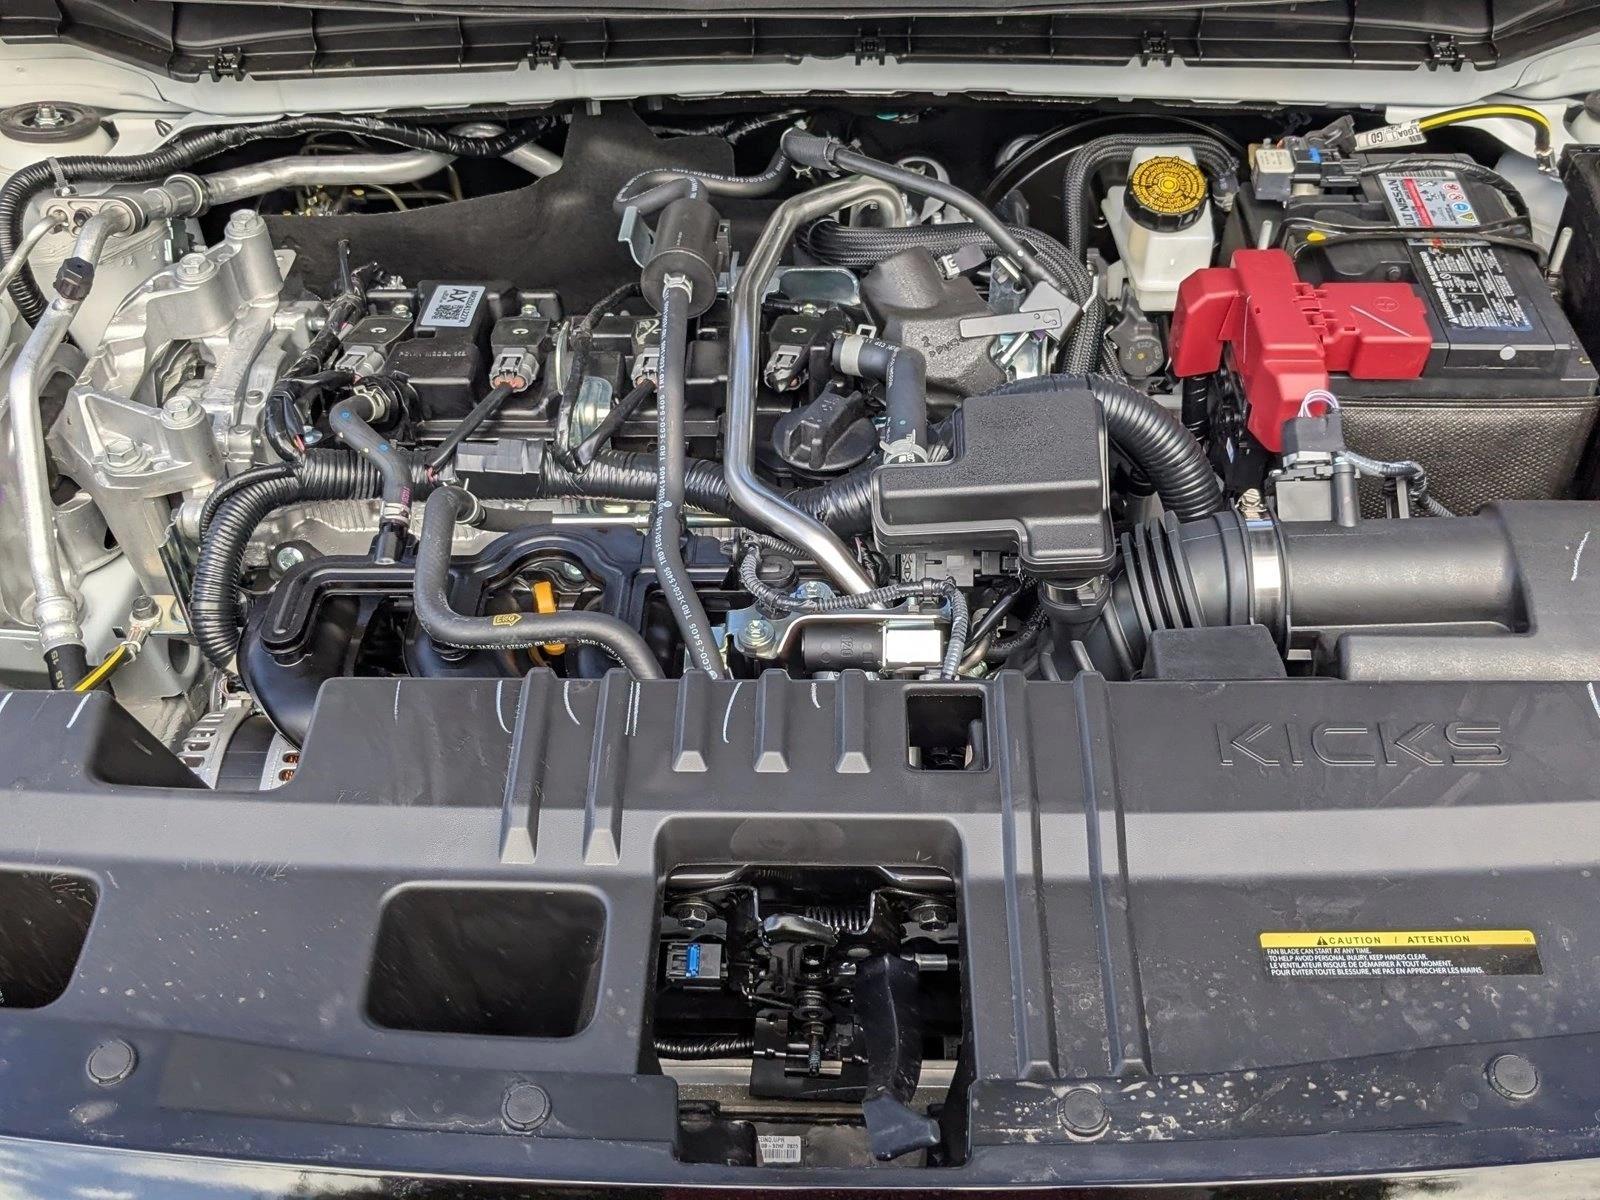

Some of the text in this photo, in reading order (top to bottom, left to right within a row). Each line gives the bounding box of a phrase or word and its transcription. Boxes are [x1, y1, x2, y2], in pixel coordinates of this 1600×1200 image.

[1388, 180, 1408, 211] NISSAN
[447, 288, 470, 303] AX
[1215, 720, 1513, 767] KICKS
[1329, 936, 1382, 946] CAUTION
[1407, 935, 1472, 945] ATTENTION
[1280, 948, 1300, 956] BLADE
[1278, 962, 1322, 970] VENTILATEUR
[1323, 961, 1348, 969] RISQUE
[1336, 968, 1372, 976] BLESSURE,
[1460, 966, 1485, 974] MAINS.
